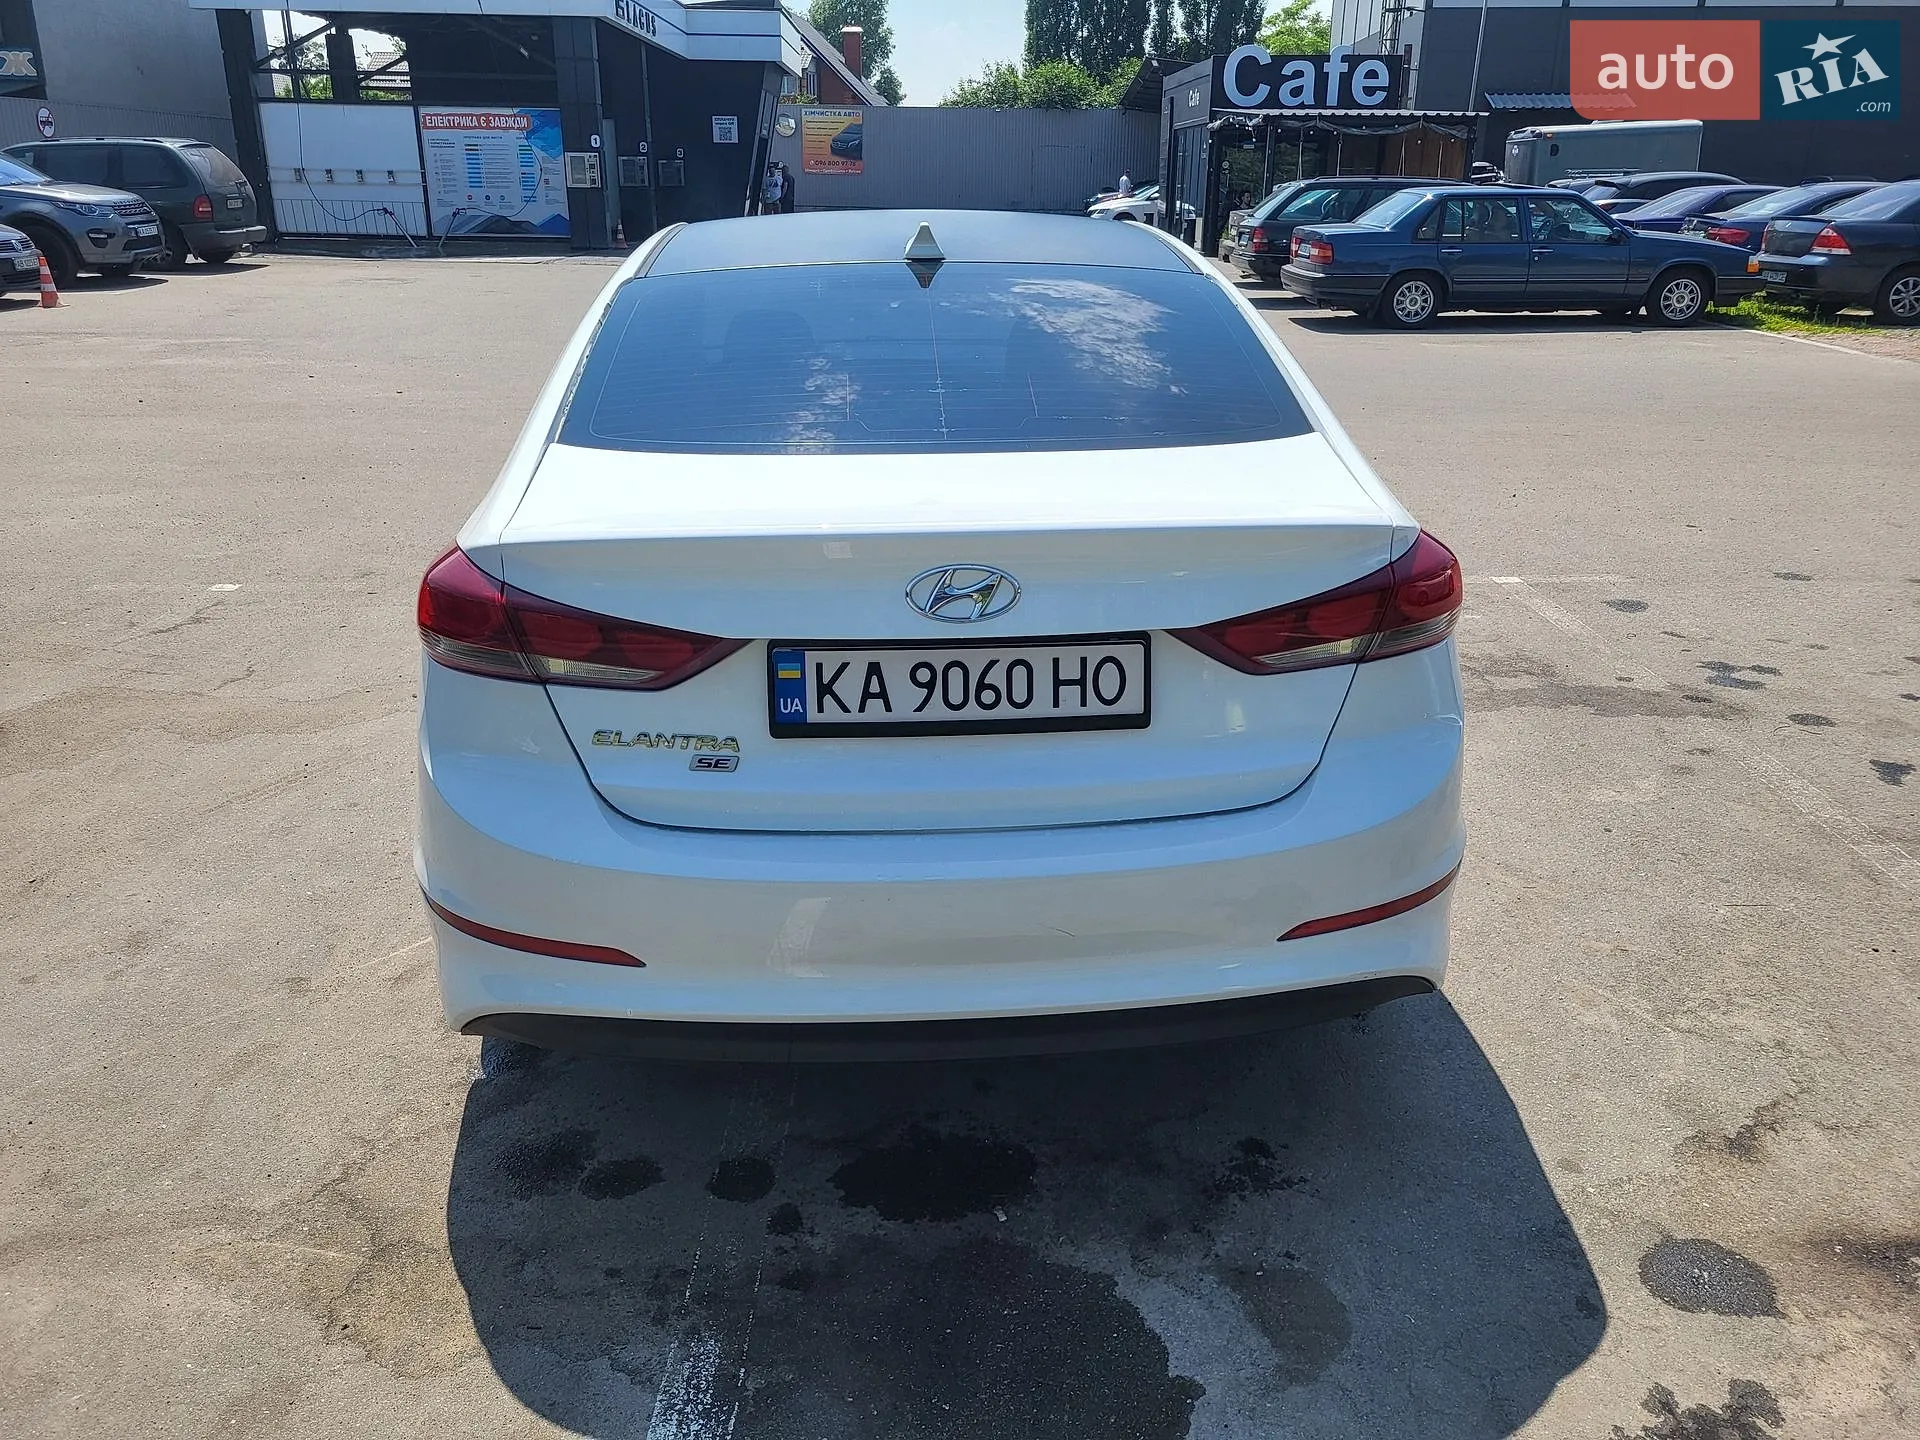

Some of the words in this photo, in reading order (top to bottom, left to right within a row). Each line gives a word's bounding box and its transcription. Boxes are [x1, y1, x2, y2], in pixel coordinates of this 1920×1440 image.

[1223, 44, 1390, 107] Cafe
[1188, 88, 1200, 107] Cafe
[426, 116, 478, 127] ЕЛЕКТРИКА
[480, 117, 487, 127] Є
[489, 116, 528, 128] ЗАВЖДИ
[780, 697, 803, 713] UA
[815, 661, 892, 714] KA
[908, 658, 1034, 713] 9060
[1052, 655, 1127, 709] HO
[591, 729, 740, 752] ELANTRA
[695, 758, 731, 769] SE
